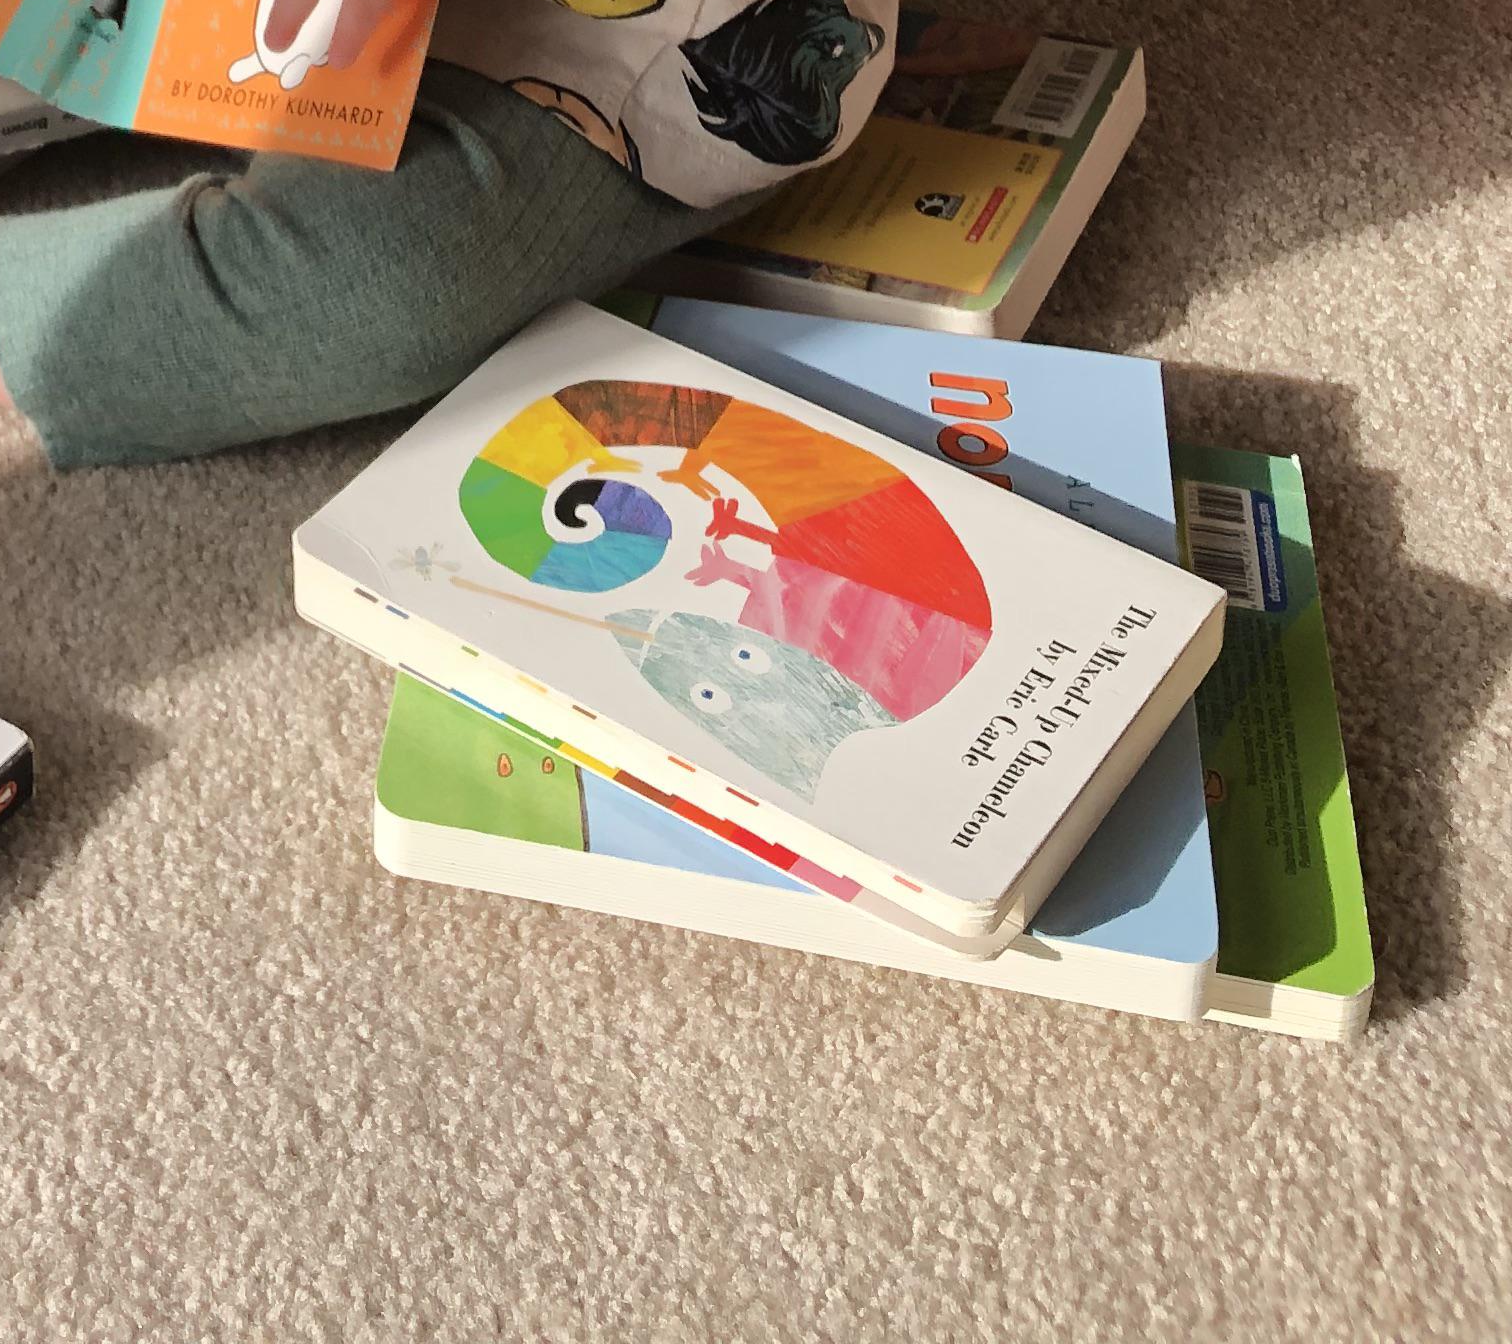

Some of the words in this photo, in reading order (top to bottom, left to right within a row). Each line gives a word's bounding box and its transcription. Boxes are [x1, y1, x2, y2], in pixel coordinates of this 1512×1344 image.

[0, 114, 50, 140] Brown
[171, 79, 193, 99] BY
[197, 81, 281, 113] DOROTHY
[284, 96, 386, 129] KUNHARDT
[1108, 604, 1155, 642] The
[1032, 638, 1078, 668] by
[1003, 666, 1056, 715] Eric
[1033, 641, 1128, 739] Mixed-Up
[959, 711, 1021, 772] Carle
[950, 736, 1056, 852] Chameleon
